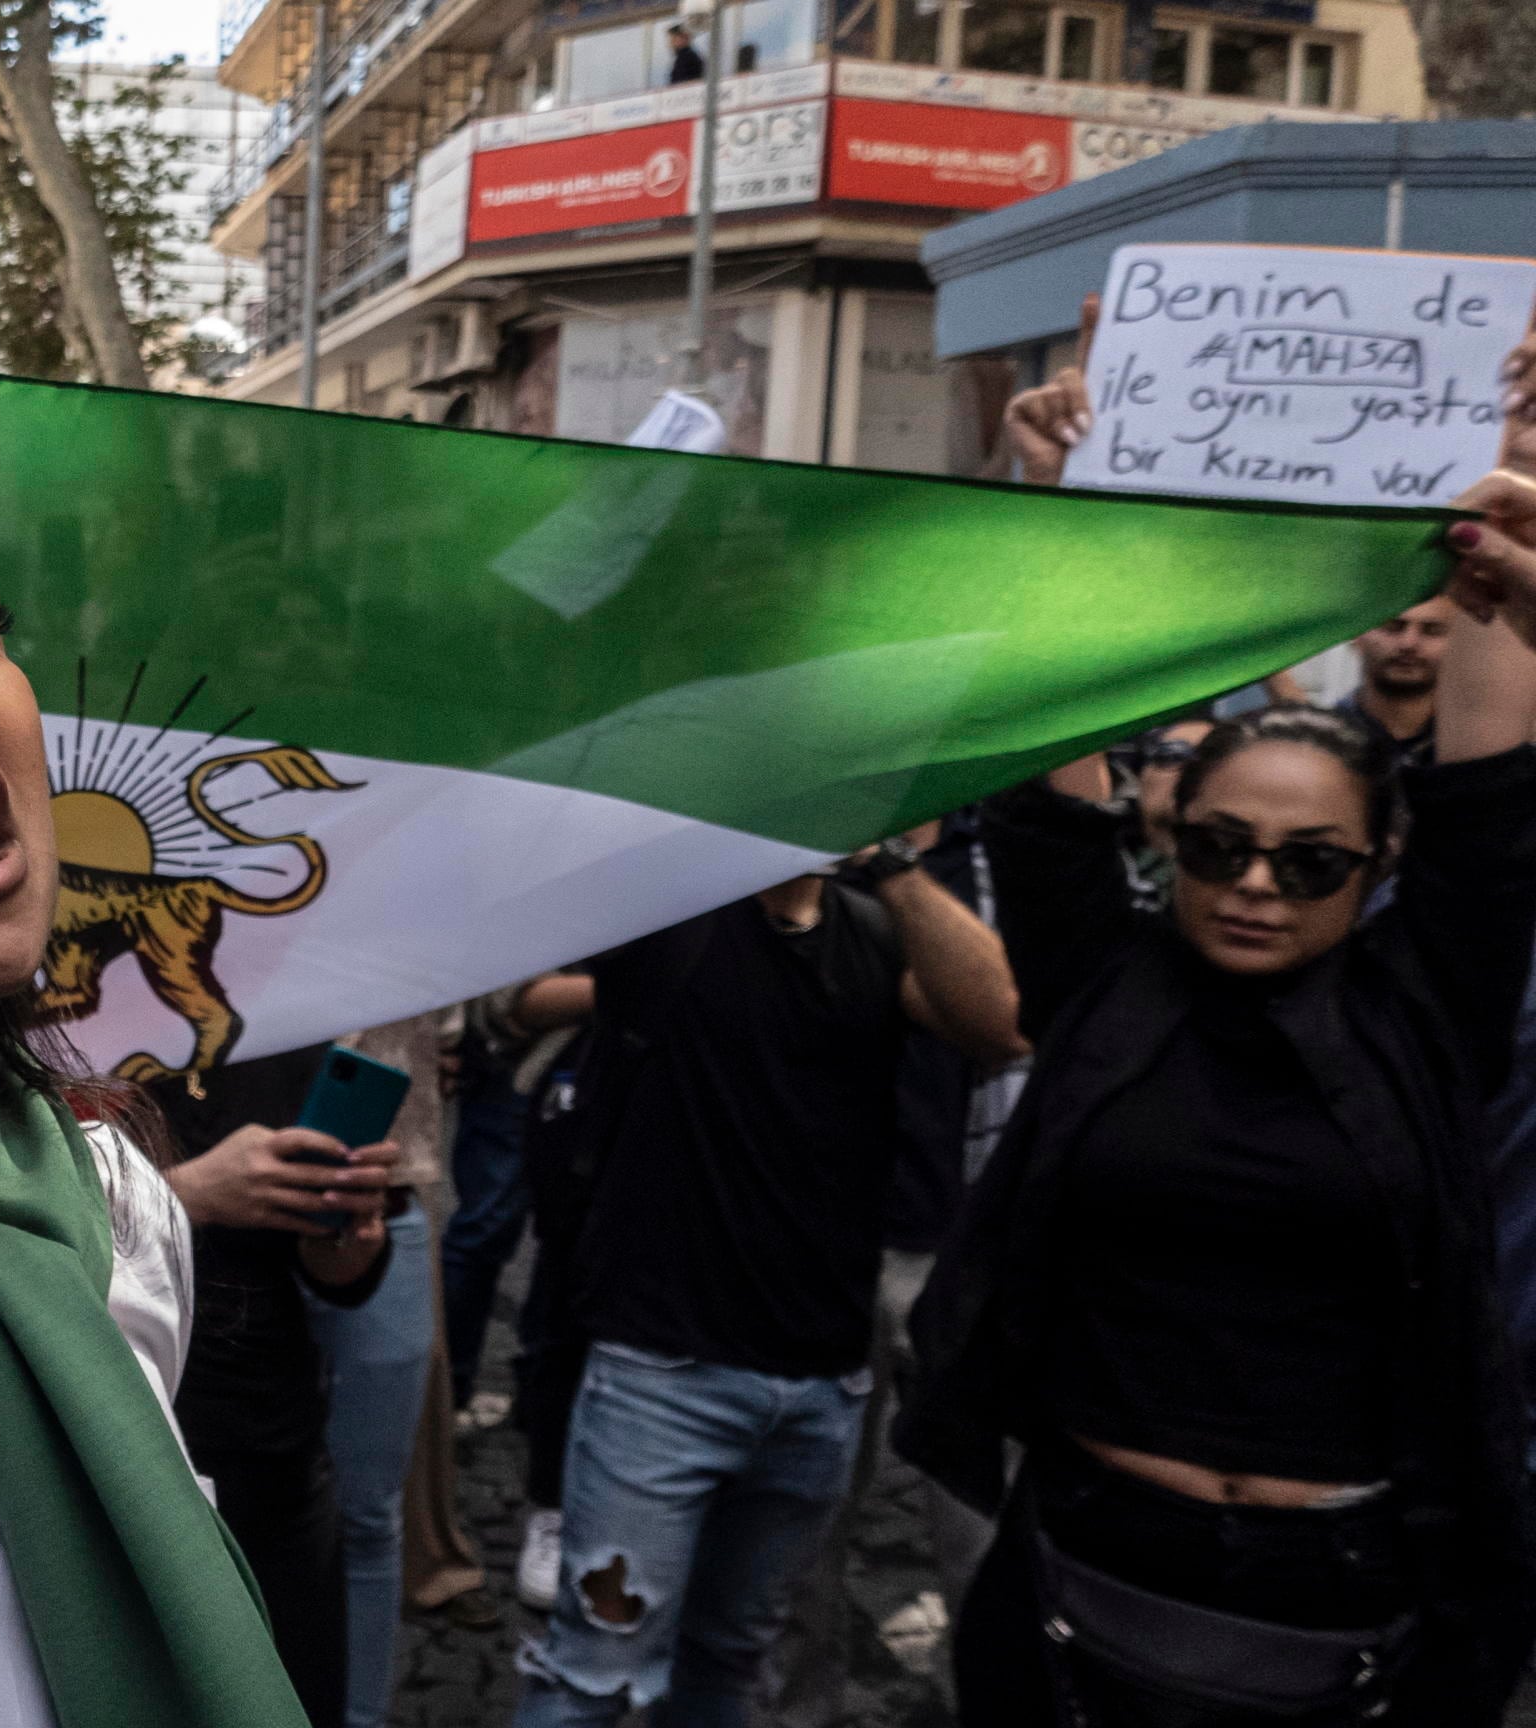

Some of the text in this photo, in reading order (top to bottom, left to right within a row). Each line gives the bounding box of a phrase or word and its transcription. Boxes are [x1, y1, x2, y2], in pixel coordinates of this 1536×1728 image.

[846, 139, 1020, 174] TURKISH AIRLINES
[480, 180, 557, 208] TURKISH
[561, 166, 646, 196] AIRLINES
[1113, 259, 1490, 327] Benim de
[1097, 353, 1499, 444] ile aynı yaşta
[1108, 421, 1164, 475] bir
